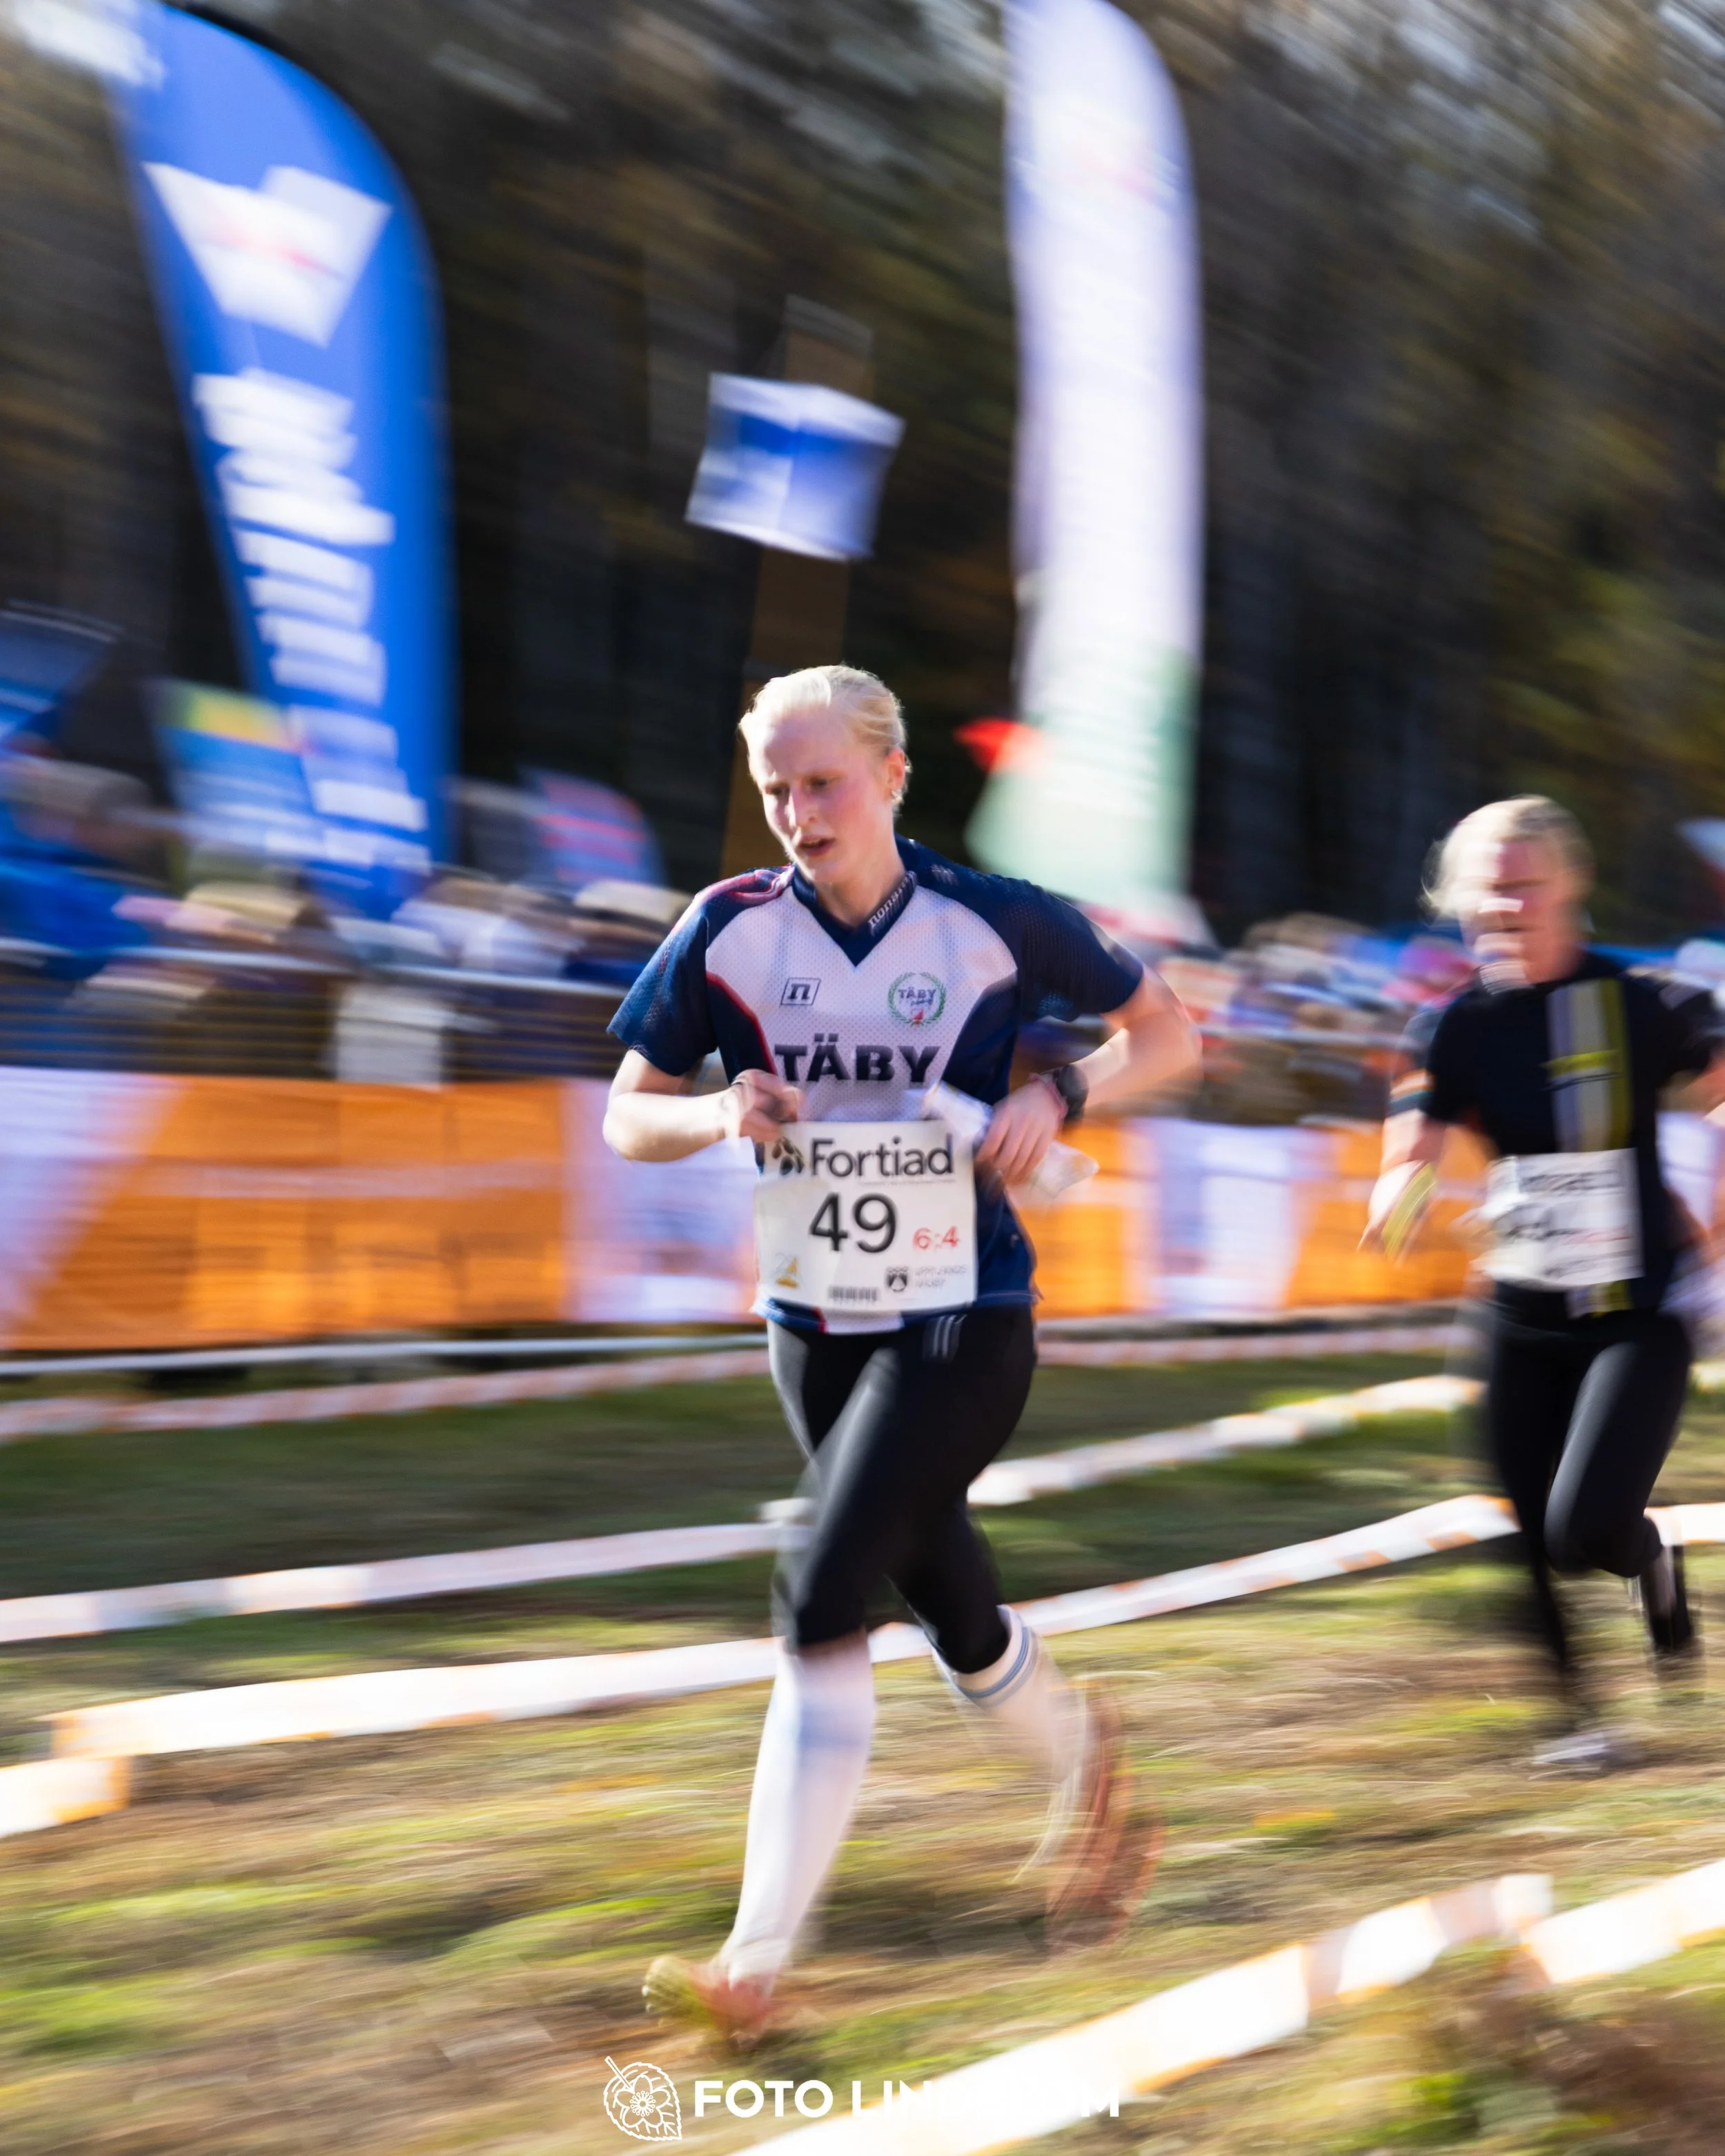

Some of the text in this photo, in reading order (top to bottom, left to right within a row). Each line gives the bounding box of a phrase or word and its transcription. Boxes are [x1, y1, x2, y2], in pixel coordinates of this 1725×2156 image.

[898, 986, 936, 998] TÄBY
[774, 1034, 940, 1082] TÄBY
[811, 1132, 954, 1177] Fortiad
[809, 1192, 898, 1253] 49
[912, 1225, 960, 1251] 6:4
